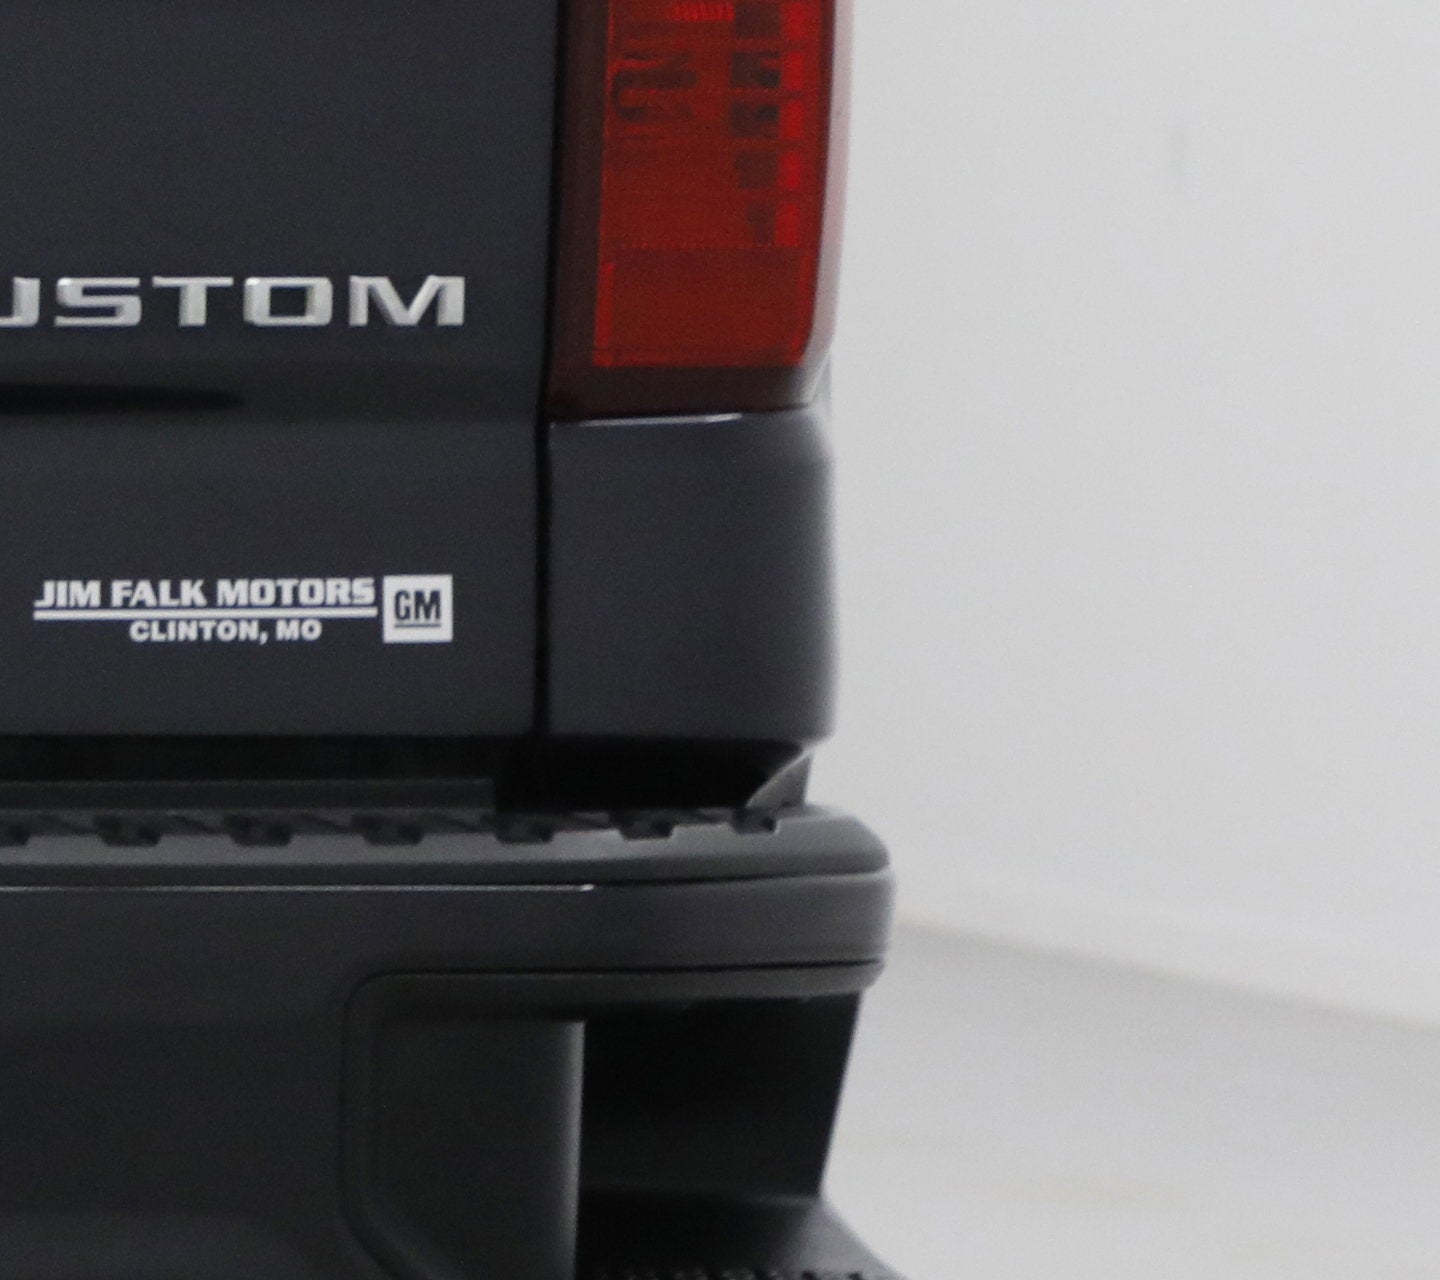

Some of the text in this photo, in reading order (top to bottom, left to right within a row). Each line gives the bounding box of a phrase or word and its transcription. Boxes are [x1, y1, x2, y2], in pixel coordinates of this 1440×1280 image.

[33, 577, 376, 609] JIM FALK MOTORS
[393, 588, 442, 621] GM
[129, 619, 323, 645] CLINTON, MO
